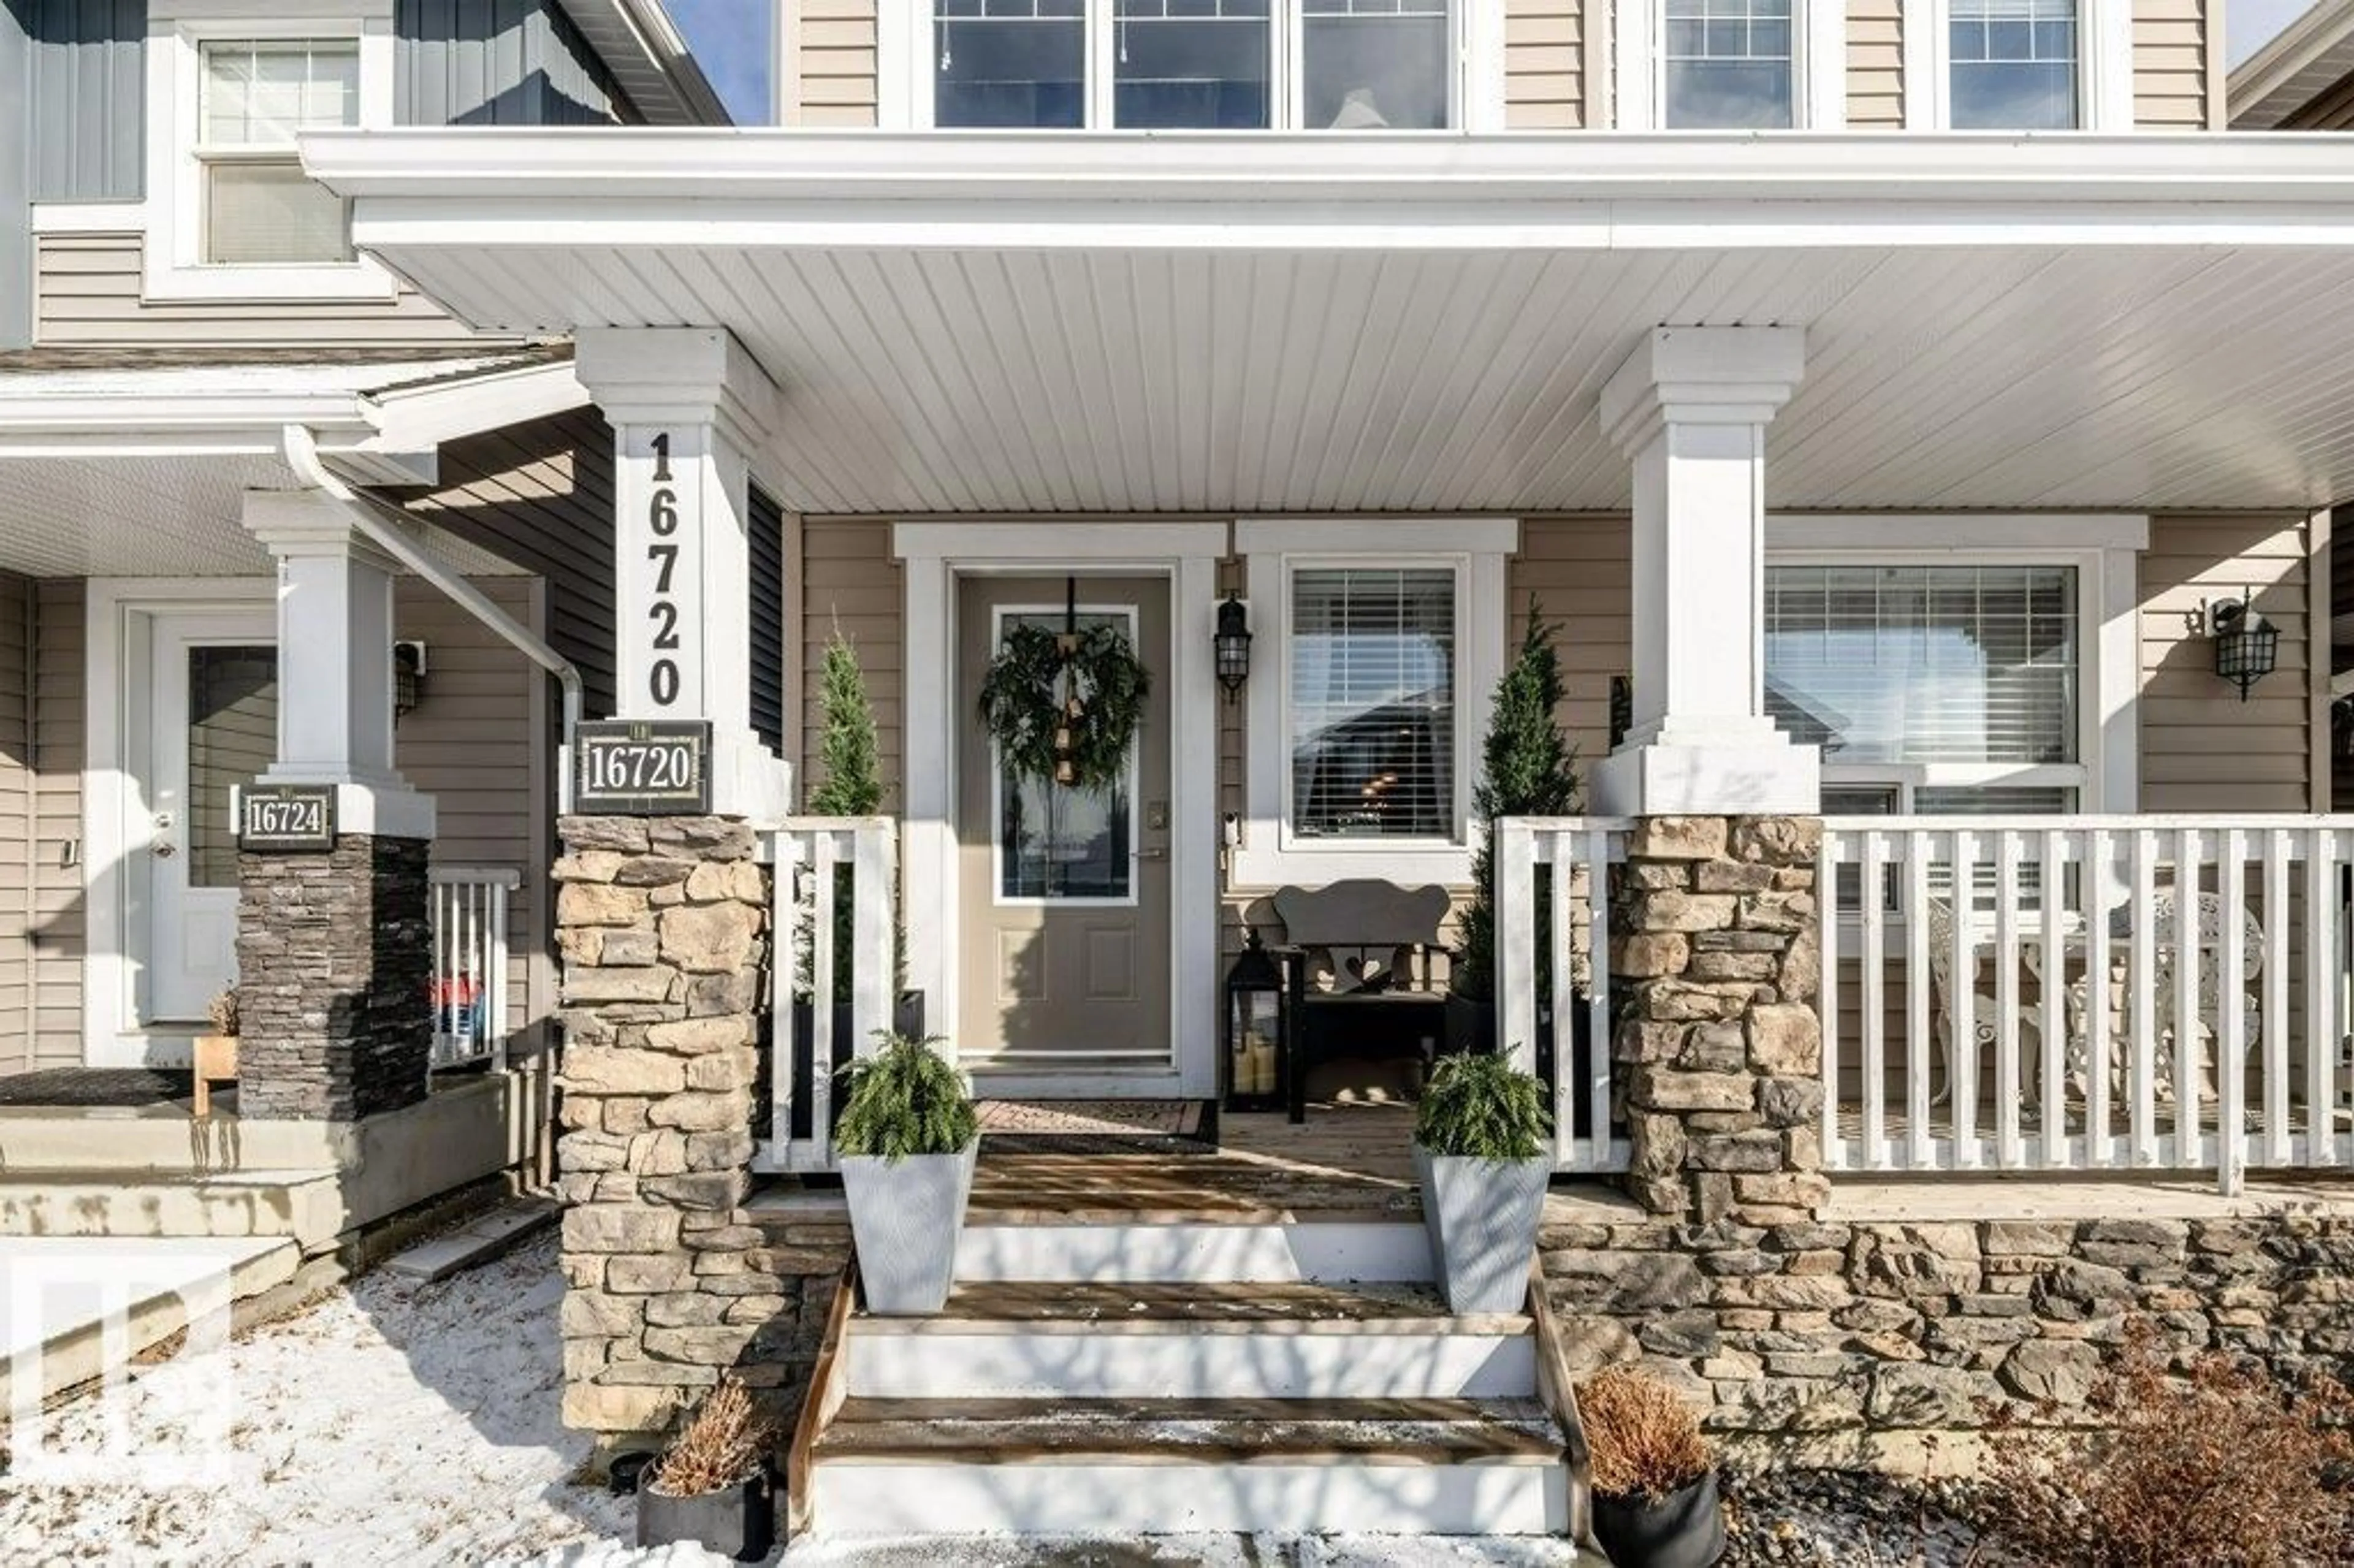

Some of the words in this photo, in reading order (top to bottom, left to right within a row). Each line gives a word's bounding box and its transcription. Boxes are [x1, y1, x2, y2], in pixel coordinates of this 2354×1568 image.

[648, 432, 679, 706] 16720
[591, 746, 689, 788] 16720
[252, 802, 320, 832] 16724
